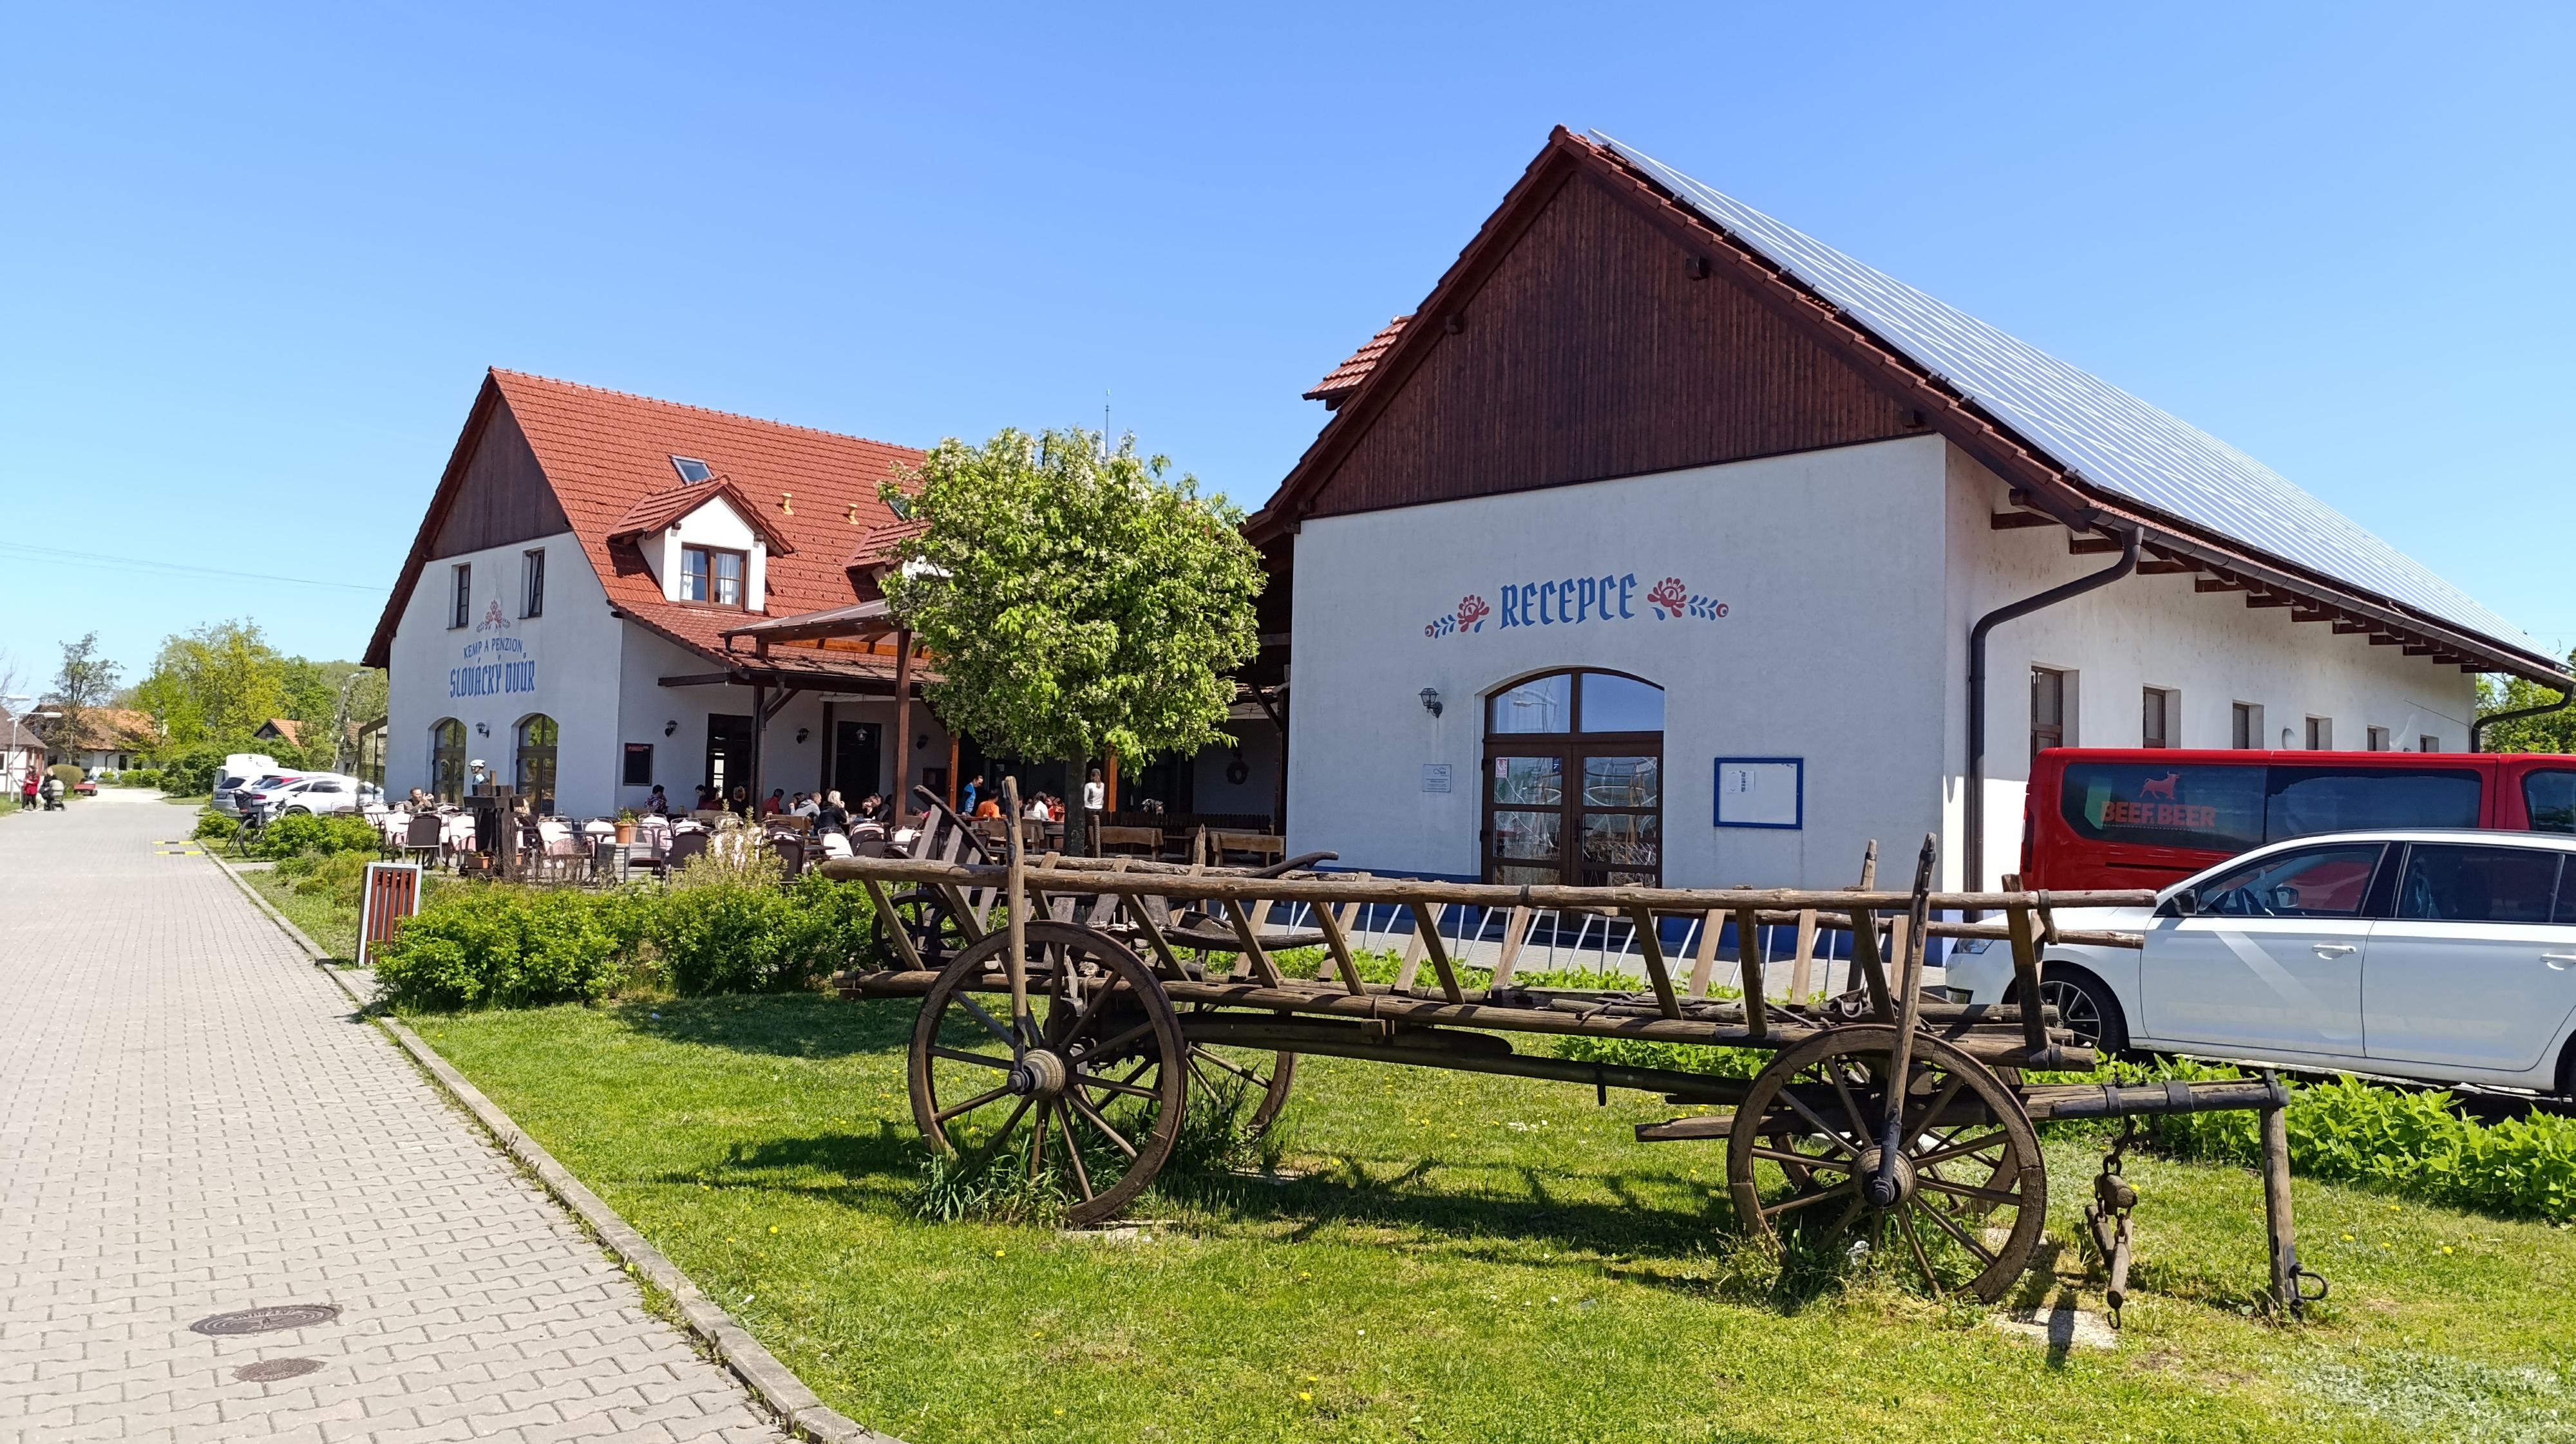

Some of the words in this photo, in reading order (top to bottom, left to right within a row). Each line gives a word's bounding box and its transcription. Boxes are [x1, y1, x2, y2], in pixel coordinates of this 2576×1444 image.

[1499, 573, 1638, 630] RECEPCE
[463, 641, 482, 659] KEMP
[484, 640, 489, 652] A
[491, 637, 523, 653] PENZION
[450, 653, 502, 698] SLOVÁCKÝ
[505, 652, 535, 693] DVŮR
